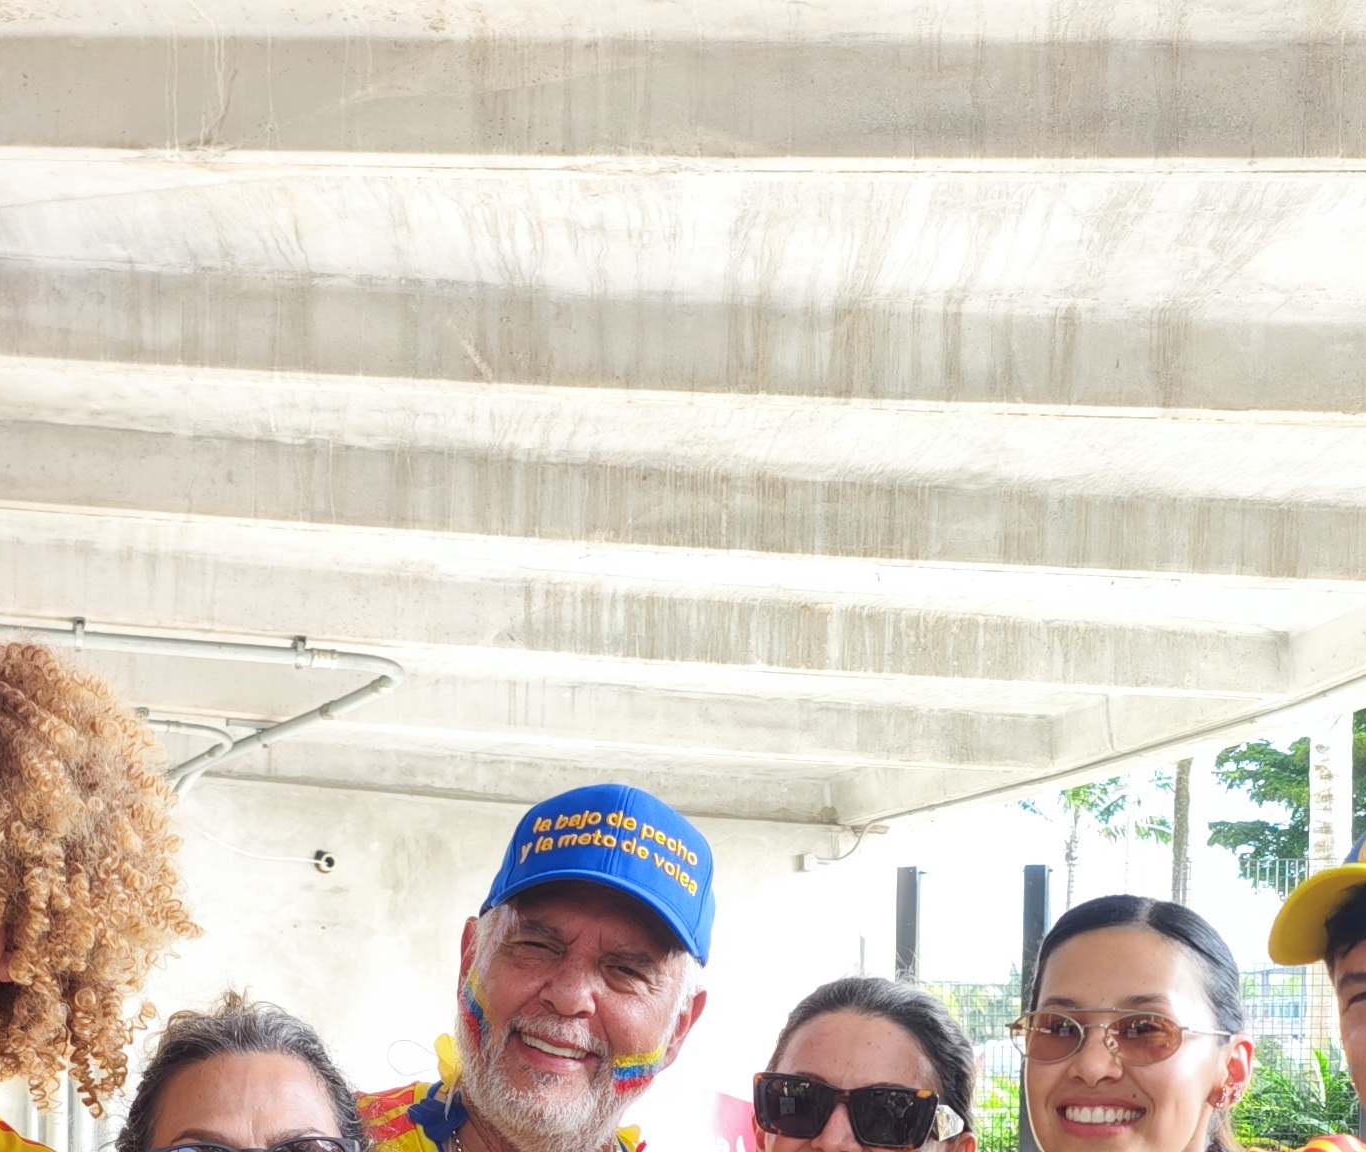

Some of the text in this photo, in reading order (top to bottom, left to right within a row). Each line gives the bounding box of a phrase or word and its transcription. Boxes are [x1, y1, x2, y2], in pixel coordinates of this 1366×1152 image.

[519, 829, 698, 896] y la meto de volea
[533, 810, 698, 866] la bajo de pecho
